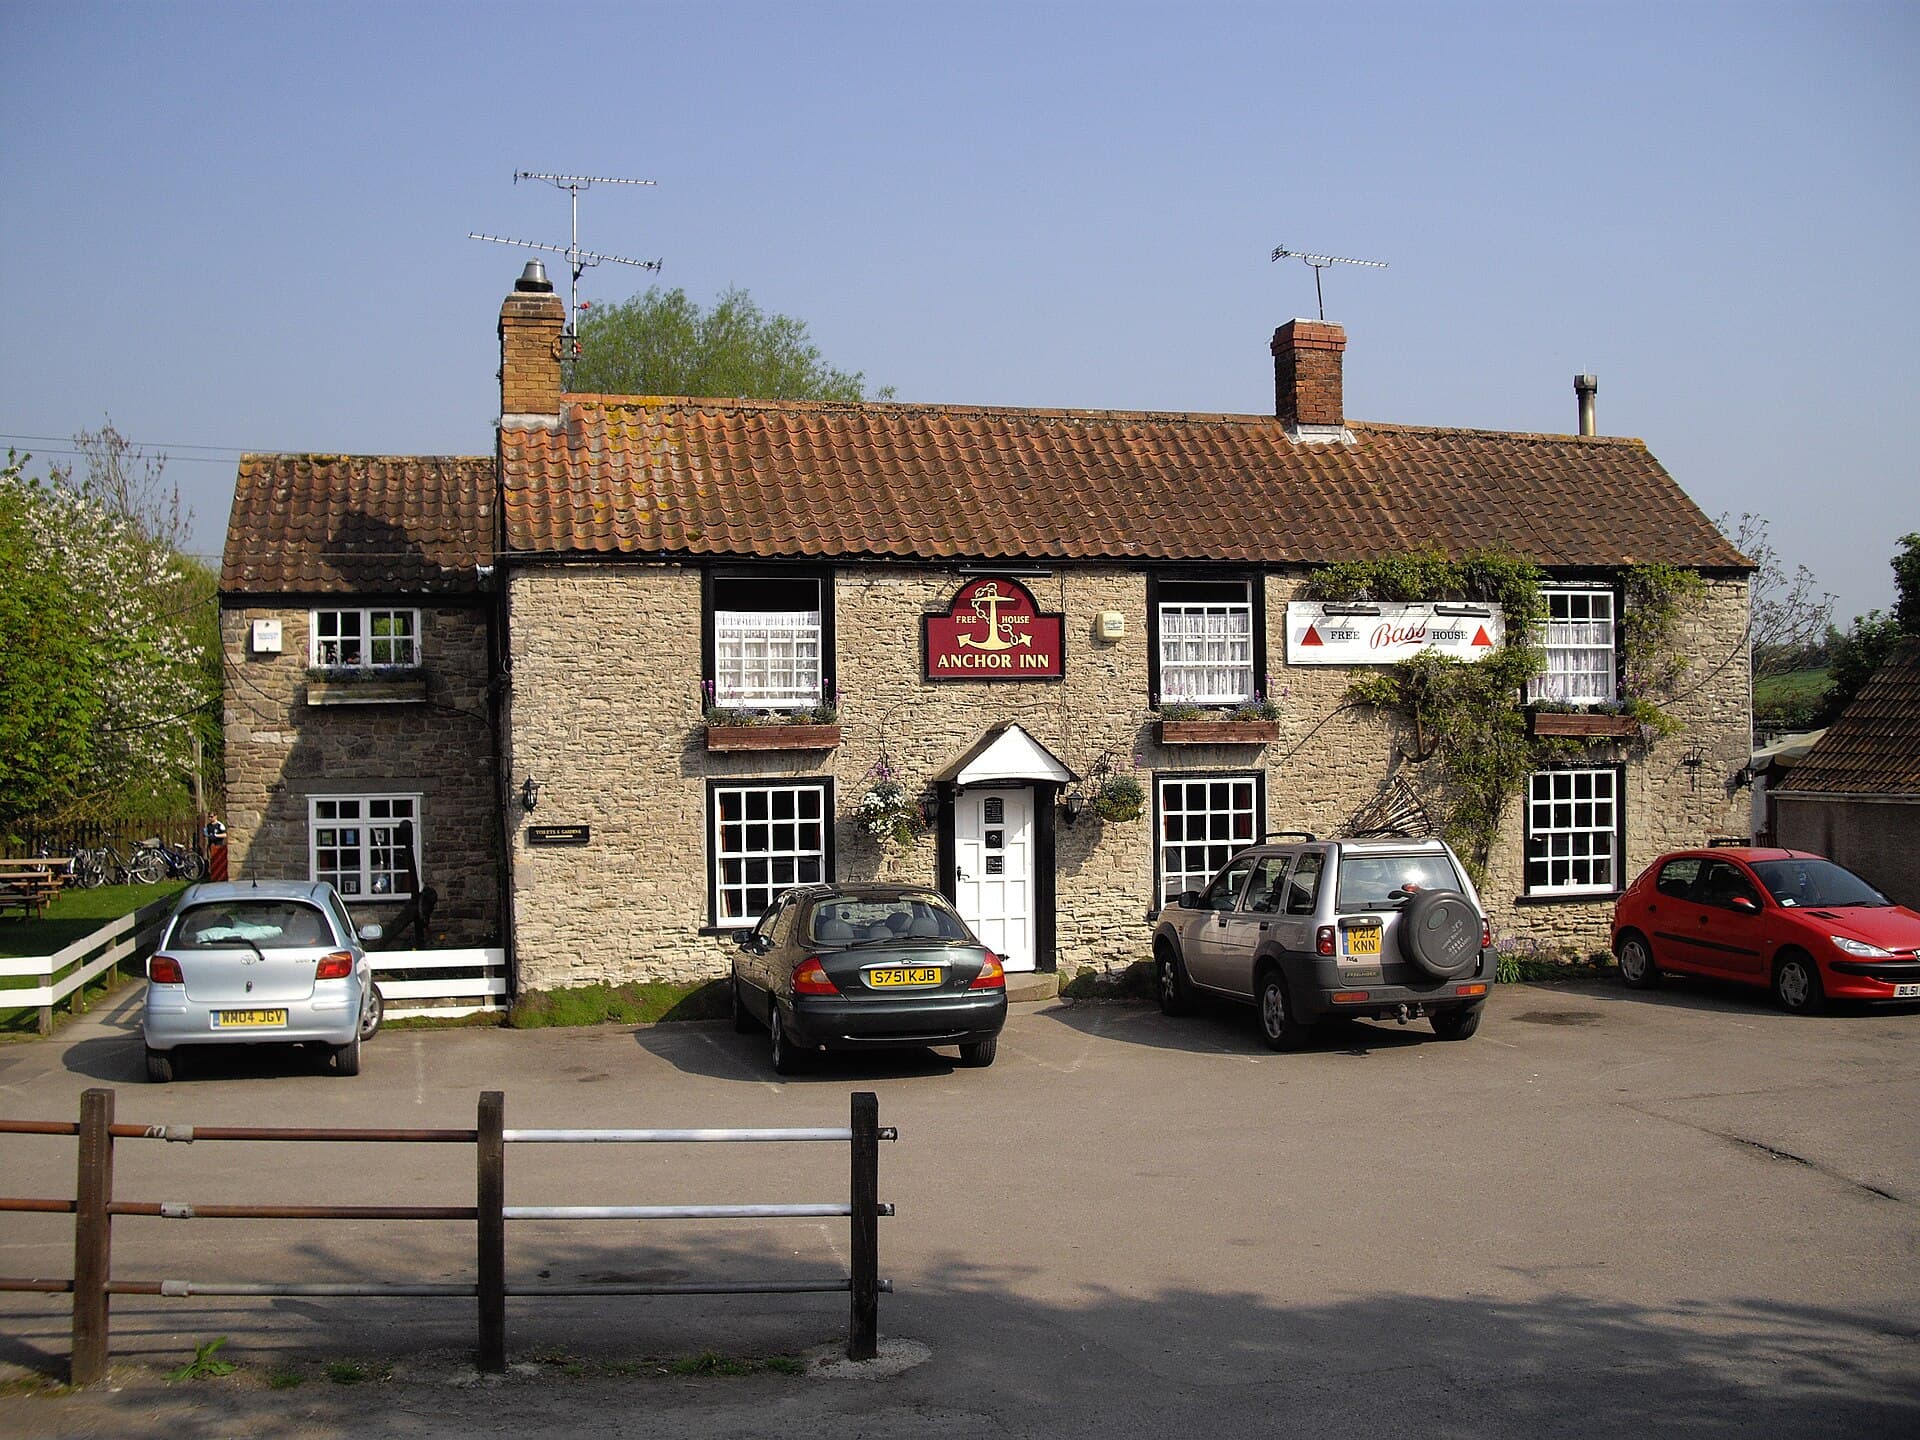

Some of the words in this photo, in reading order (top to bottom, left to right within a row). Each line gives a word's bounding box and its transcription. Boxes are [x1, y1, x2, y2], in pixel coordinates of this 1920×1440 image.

[956, 615, 977, 624] FREE
[1002, 615, 1030, 624] HOUSE
[1331, 631, 1360, 640] FREE
[1370, 623, 1426, 650] Bass
[1432, 631, 1468, 640] HOUSE
[937, 654, 1012, 668] ANCHOR
[1020, 654, 1049, 668] INN
[1351, 927, 1376, 939] Y212
[1353, 940, 1376, 951] KNN
[875, 970, 905, 983] S751
[909, 969, 935, 982] KJB
[259, 1010, 282, 1023] JGV
